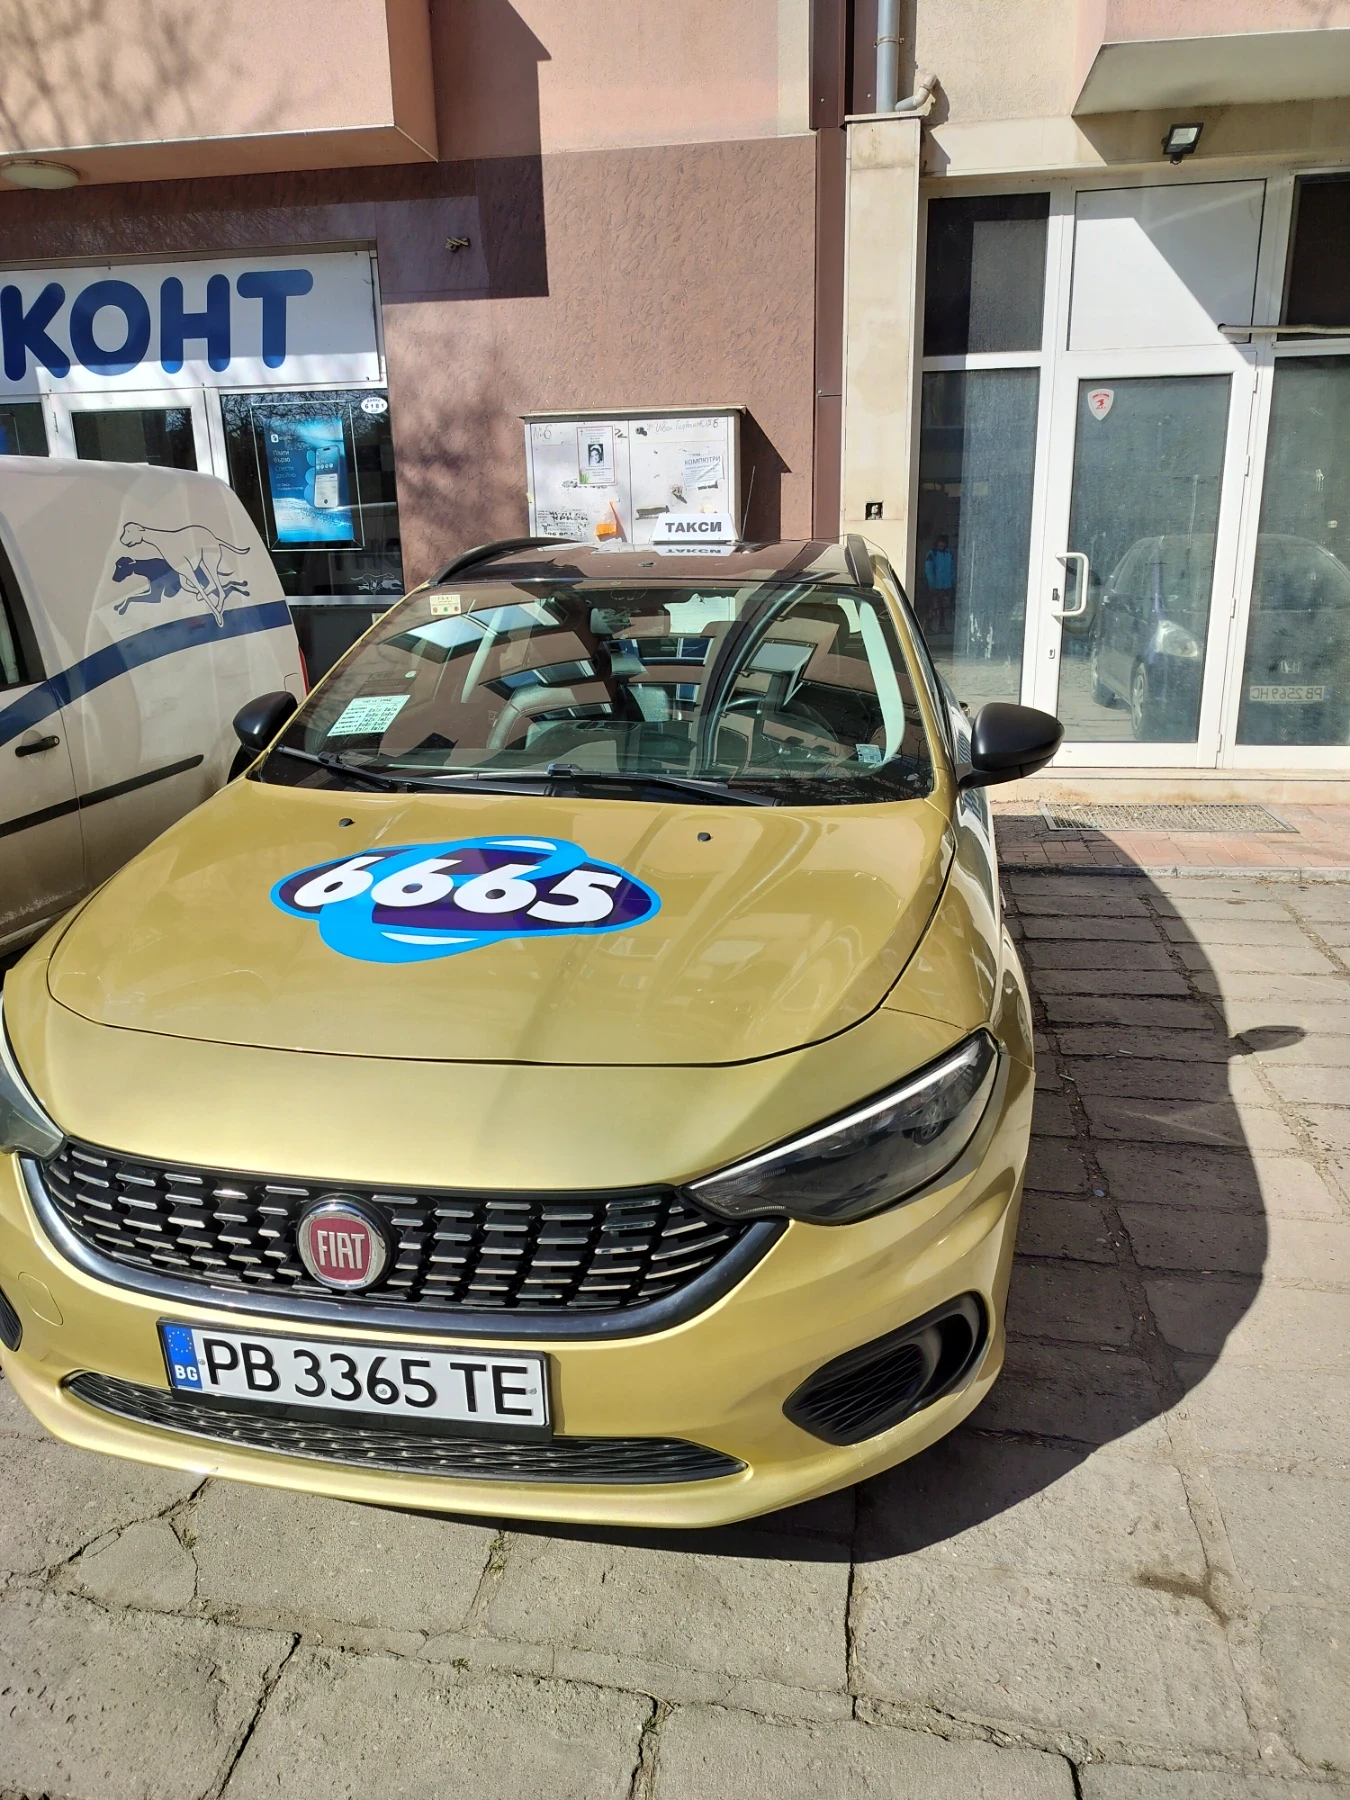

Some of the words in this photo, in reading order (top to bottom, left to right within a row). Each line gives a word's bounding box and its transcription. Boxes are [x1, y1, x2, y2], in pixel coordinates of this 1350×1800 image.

[1, 268, 314, 382] КОНТ
[684, 456, 721, 466] КОМПЮТРИ
[665, 522, 722, 533] ТАКСИ
[294, 856, 622, 923] 6665
[317, 1230, 366, 1270] FIAT
[175, 1364, 198, 1382] BG
[202, 1337, 281, 1392] PB
[293, 1349, 437, 1409] 3365
[449, 1361, 533, 1417] TE
